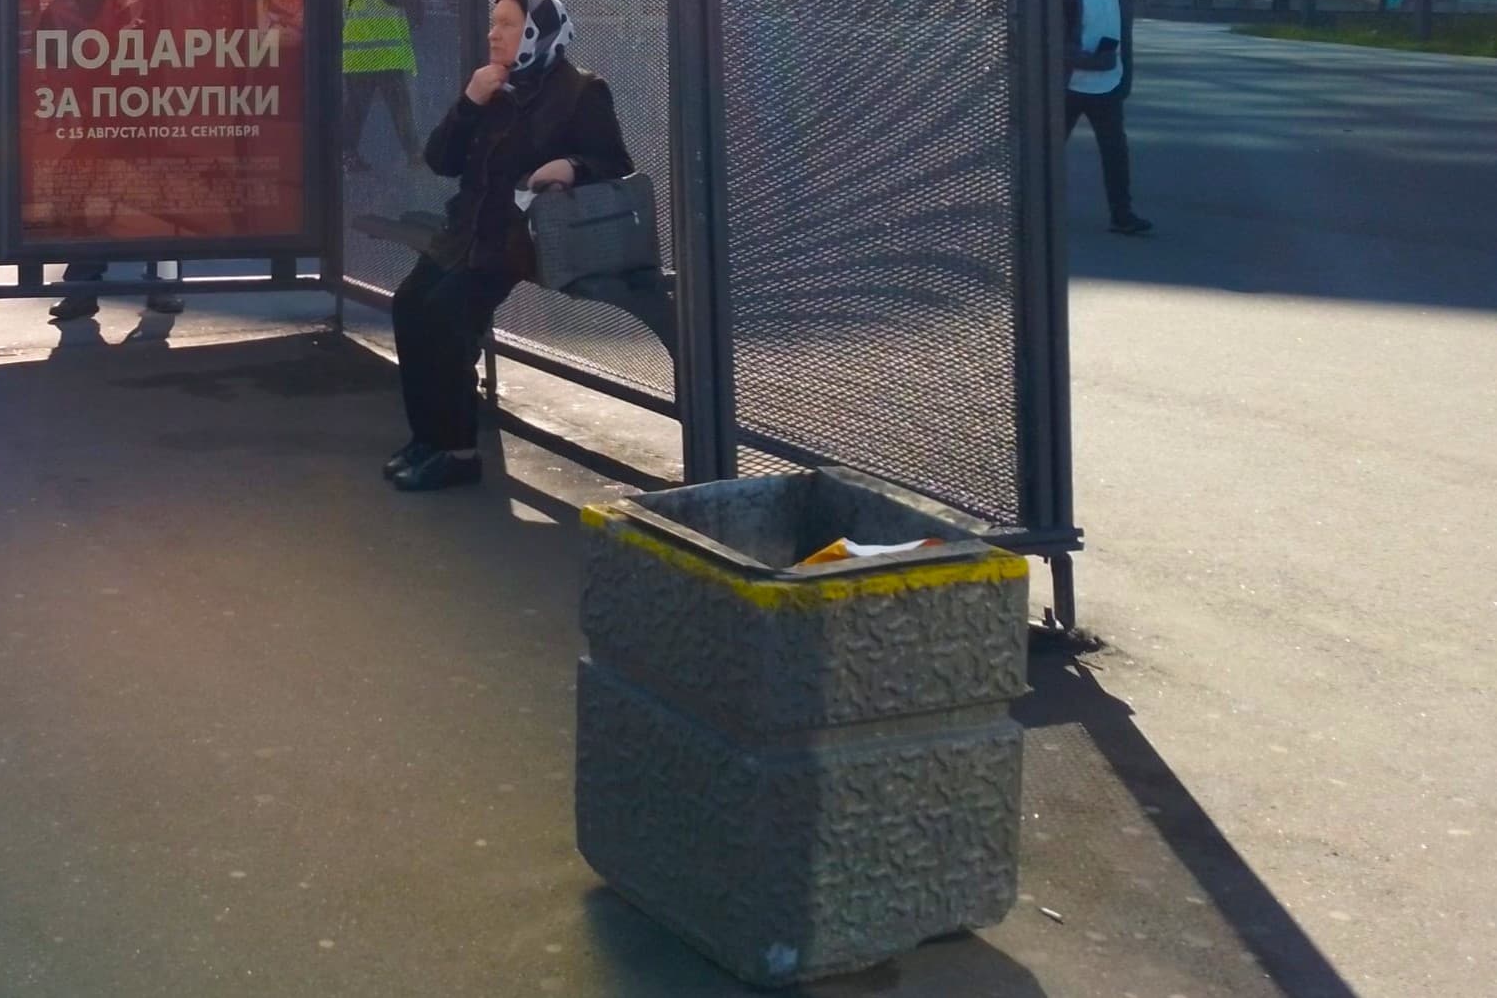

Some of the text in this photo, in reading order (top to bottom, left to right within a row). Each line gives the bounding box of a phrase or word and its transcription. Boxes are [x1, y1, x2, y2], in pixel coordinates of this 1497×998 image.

[35, 29, 280, 75] ПОДАРКИ
[35, 85, 280, 118] ЗА ПОКУПКИ
[56, 125, 260, 139] С 15 АВГУСТА ПО 21 СЕНТЯБРЯ
